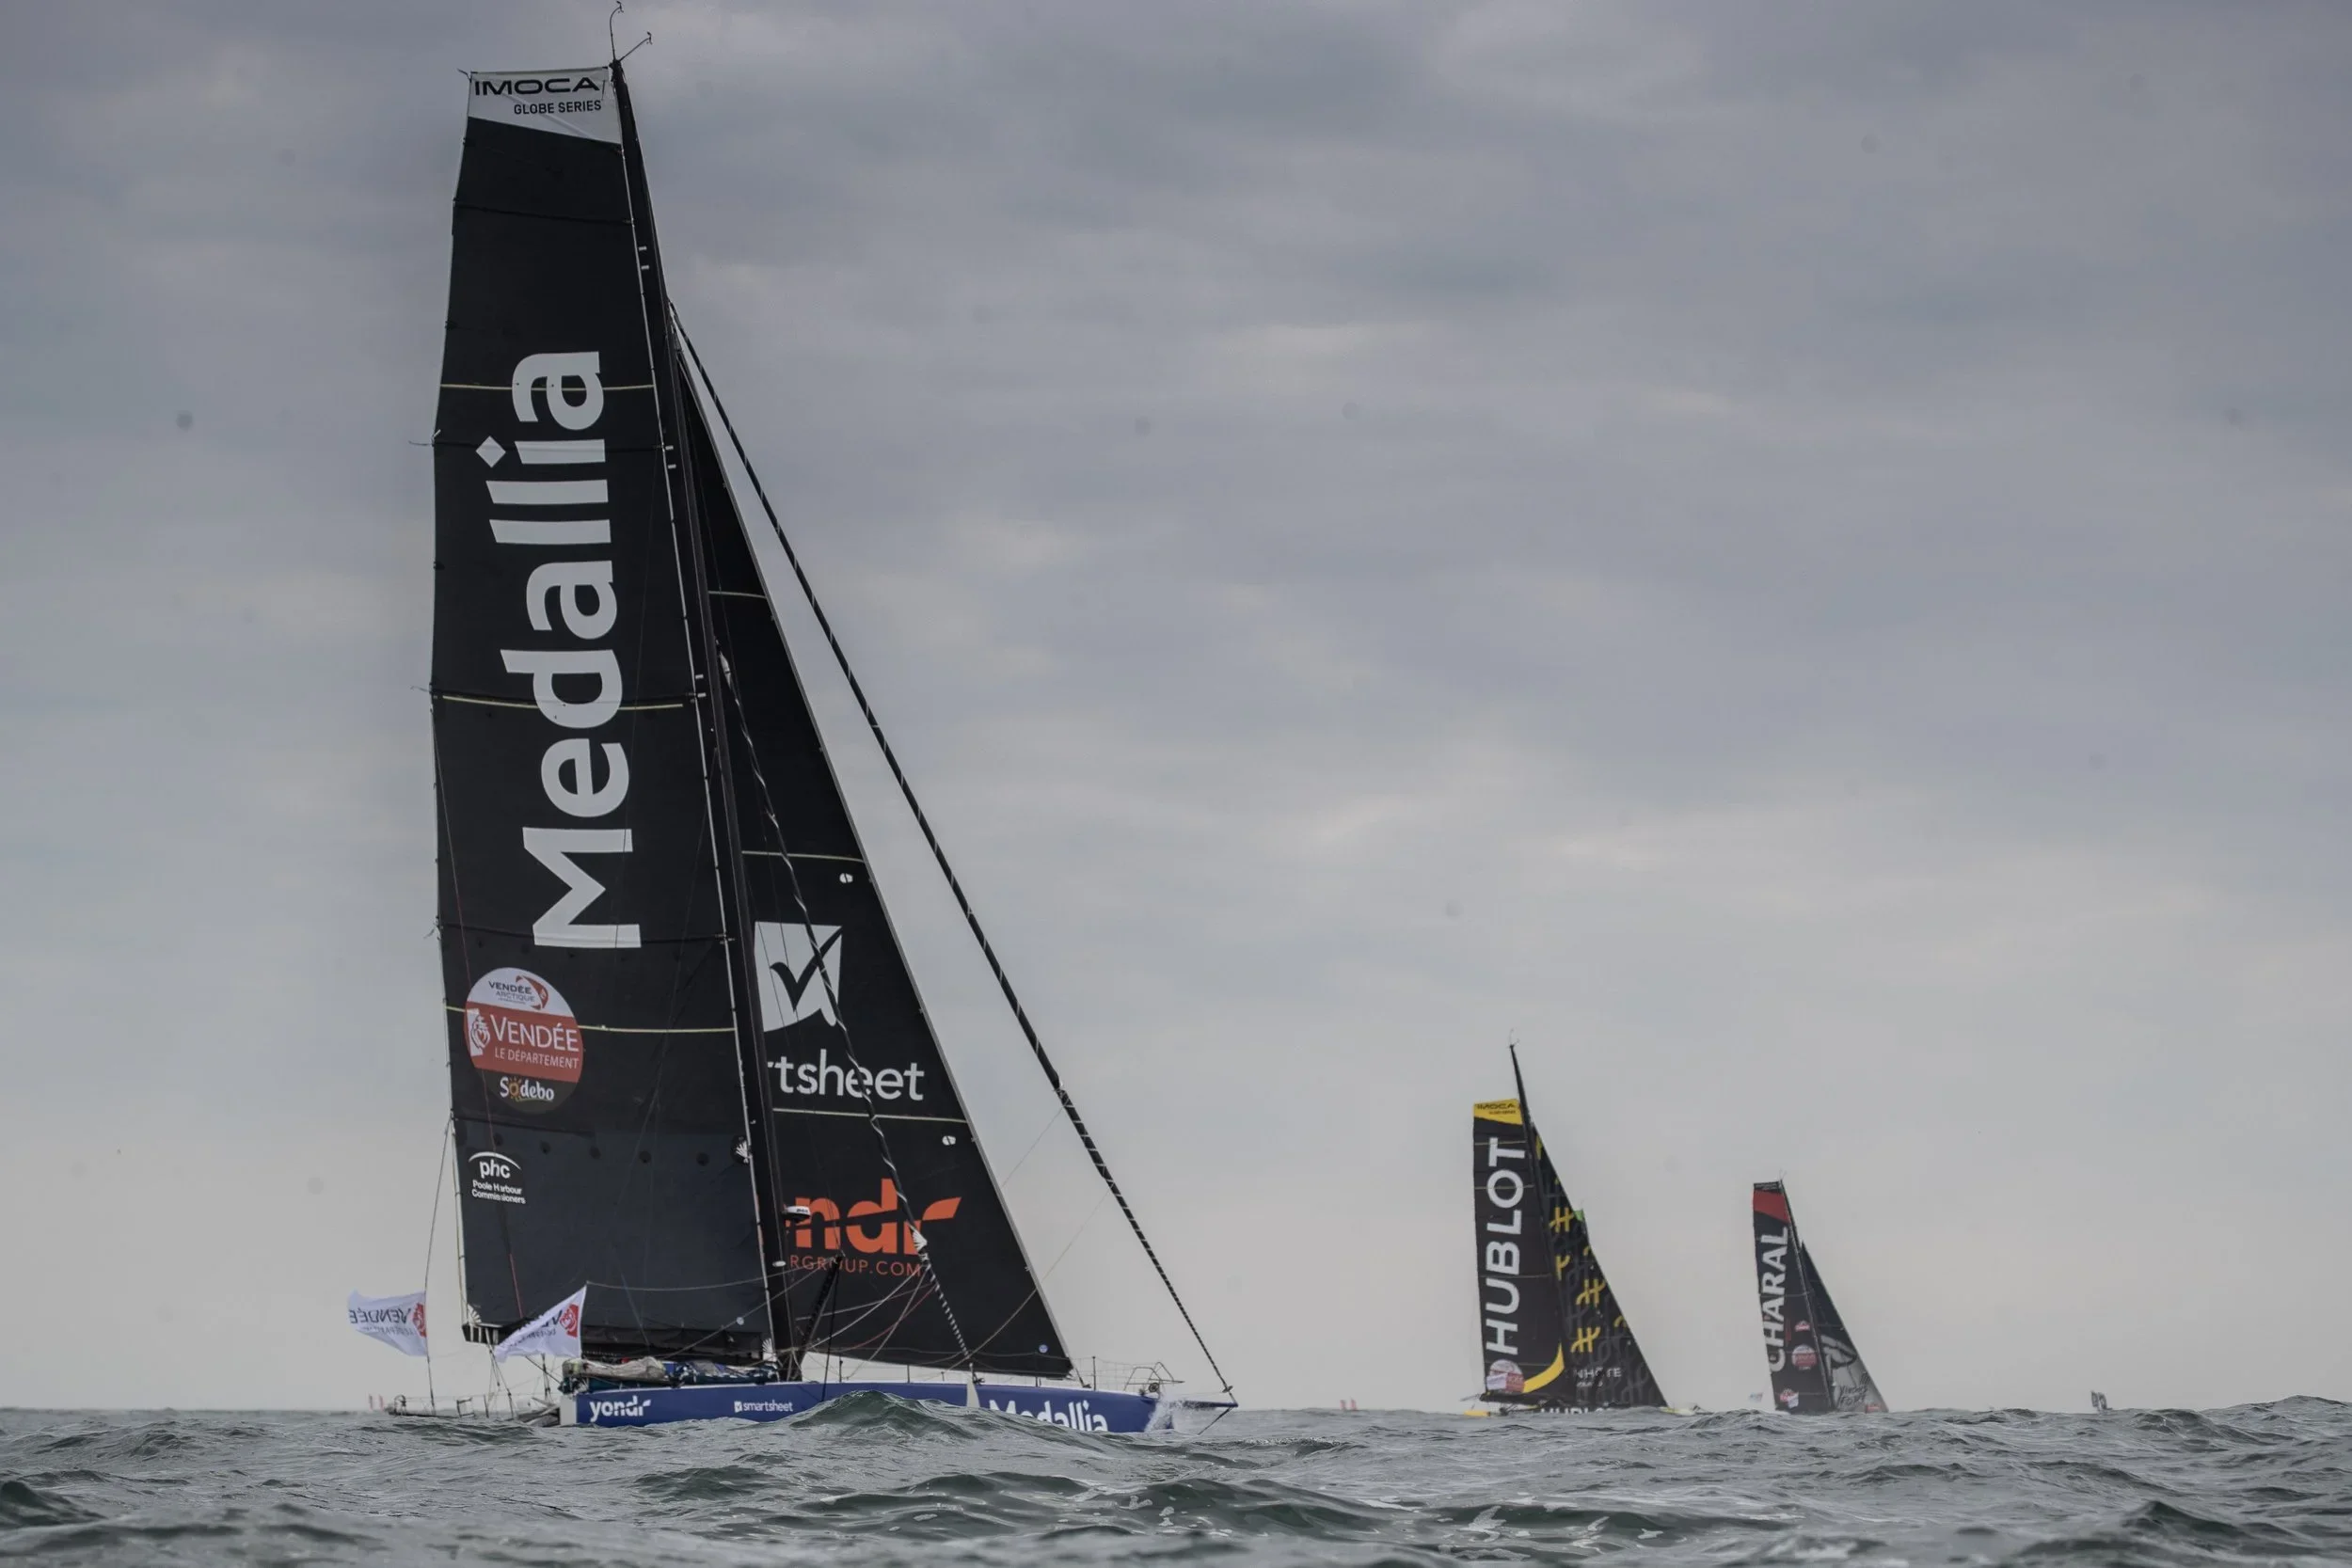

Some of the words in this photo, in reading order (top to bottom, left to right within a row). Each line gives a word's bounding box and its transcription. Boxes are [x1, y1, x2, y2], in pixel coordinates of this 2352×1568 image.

[475, 77, 600, 95] IMOCA
[514, 103, 555, 115] GLOBE
[558, 100, 601, 113] SERIES
[475, 351, 642, 948] Medallia
[488, 980, 532, 994] VENDÉE
[489, 1014, 580, 1053] VENDÉE
[495, 1046, 505, 1060] LE
[508, 1047, 580, 1069] DÉPARTEMENT
[768, 1048, 925, 1101] tsheet
[480, 1159, 511, 1179] phc
[472, 1179, 492, 1191] Poole
[471, 1188, 527, 1204] Commissioners
[1486, 1137, 1525, 1355] HUBLOT
[1761, 1226, 1788, 1373] CHARAL
[589, 1395, 651, 1422] yondr
[742, 1400, 793, 1412] smartsheet
